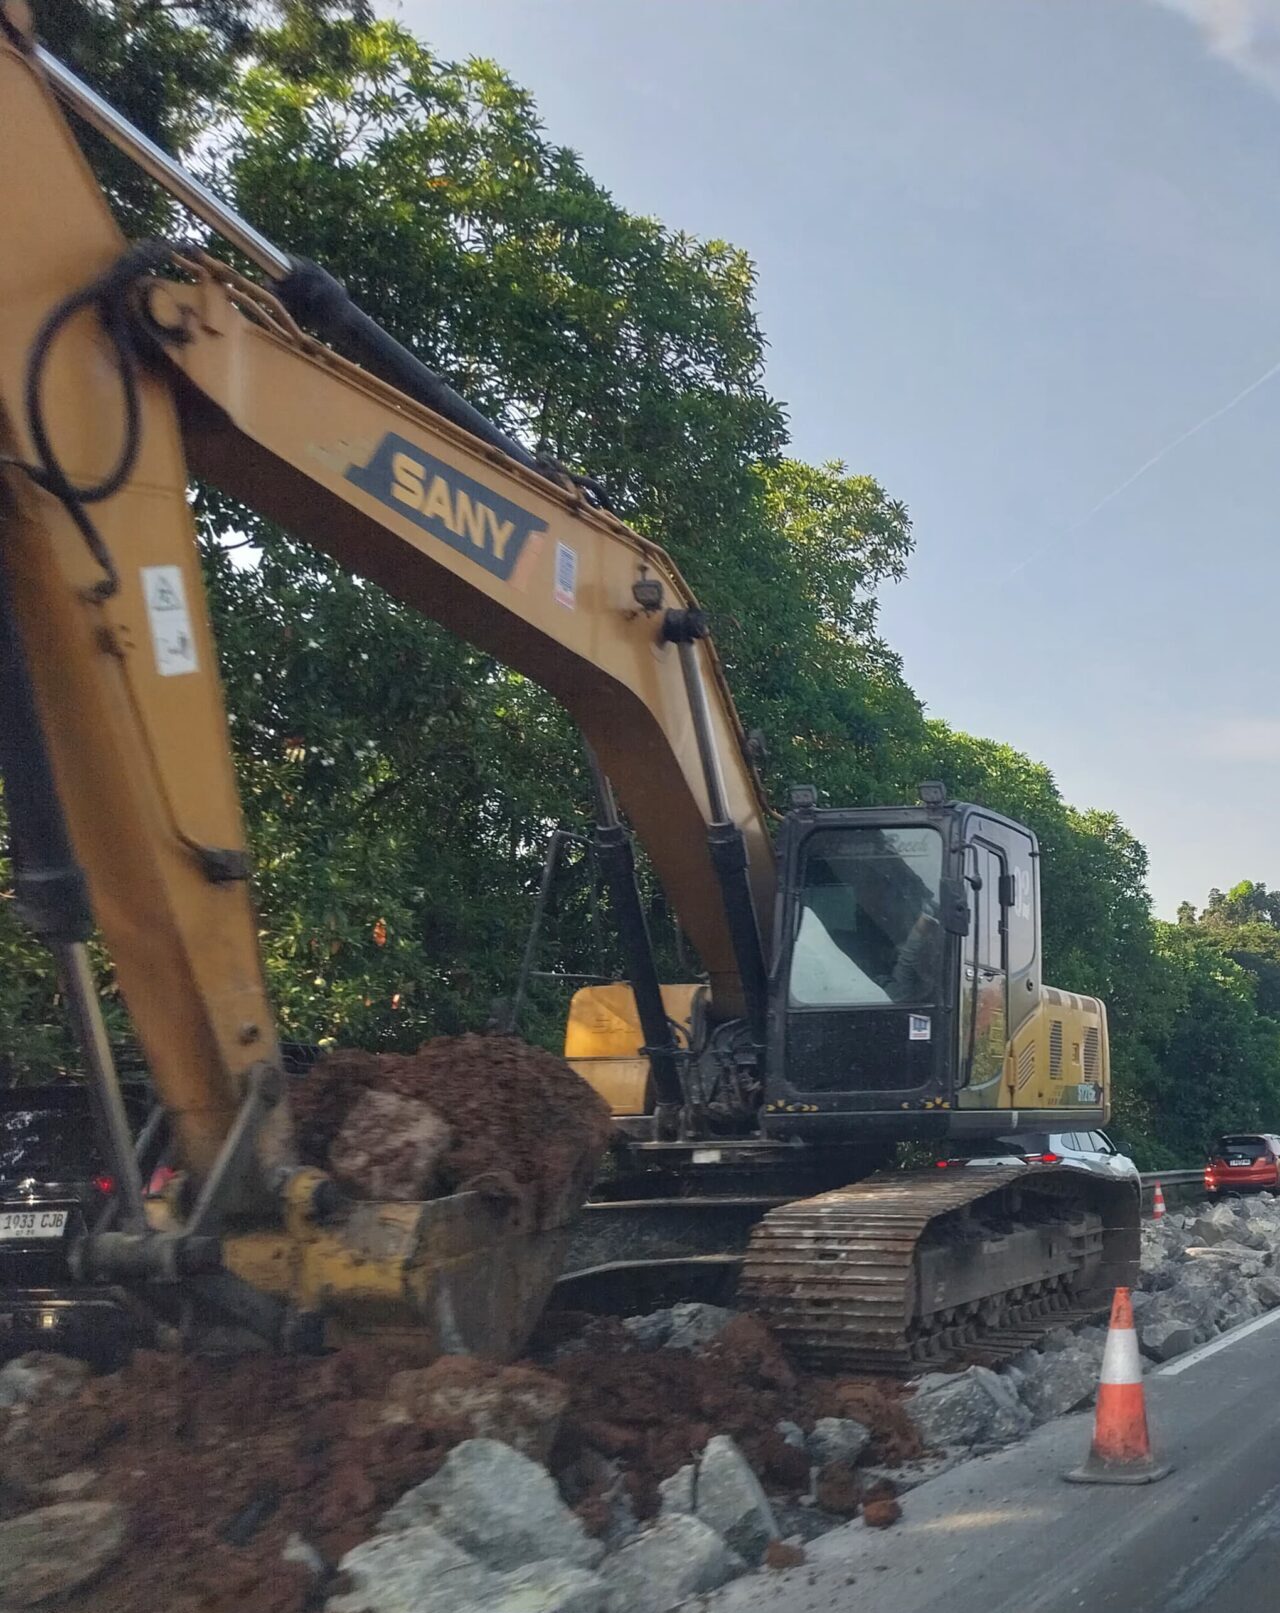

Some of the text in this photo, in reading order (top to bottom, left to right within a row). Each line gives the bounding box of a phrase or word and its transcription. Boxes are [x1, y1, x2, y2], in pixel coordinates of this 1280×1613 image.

[391, 452, 516, 561] SANY
[3, 1213, 64, 1230] 1933 CJB
